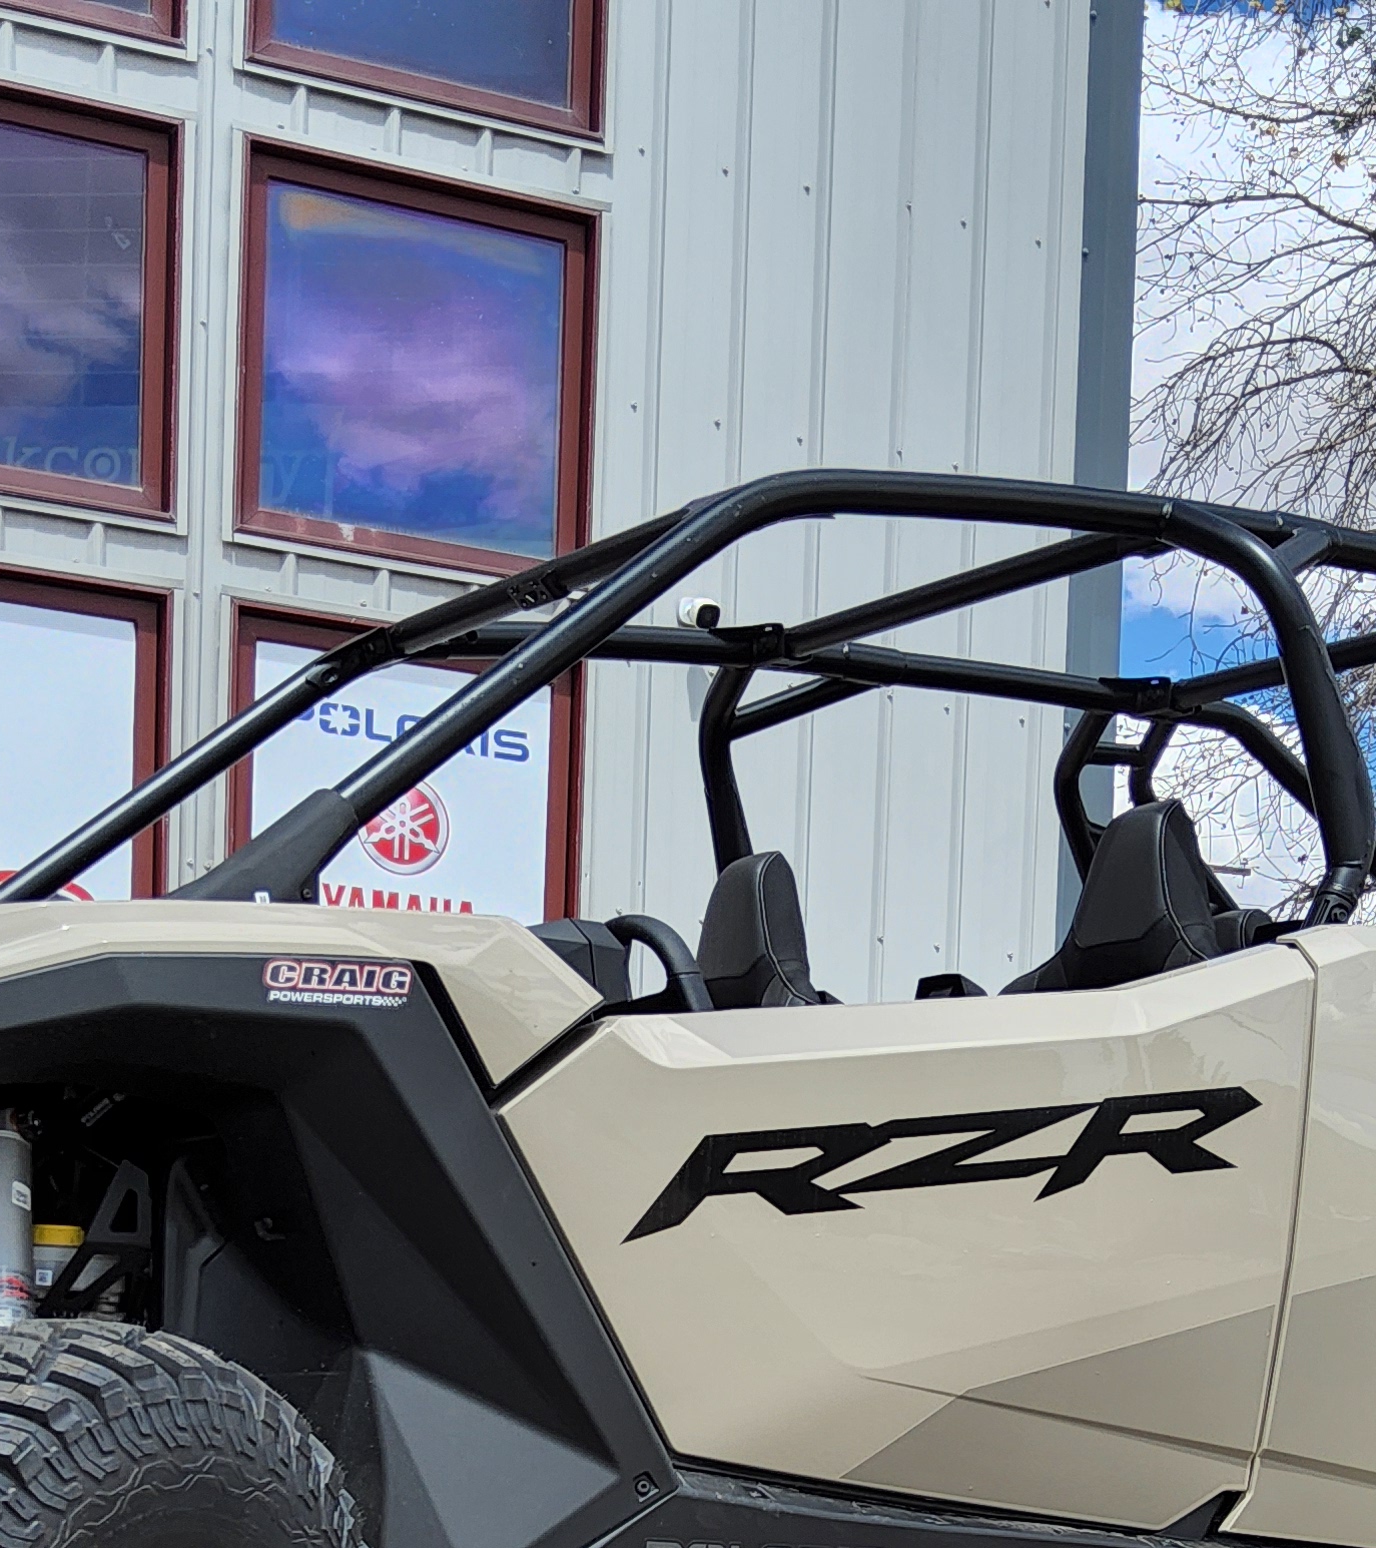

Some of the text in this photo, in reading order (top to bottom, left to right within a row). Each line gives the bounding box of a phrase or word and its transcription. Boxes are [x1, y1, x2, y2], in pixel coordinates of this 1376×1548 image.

[295, 702, 530, 762] OLAIS
[264, 959, 412, 994] CRAIG
[269, 990, 383, 1006] POWERSPORTS
[620, 1086, 1263, 1246] RZR
